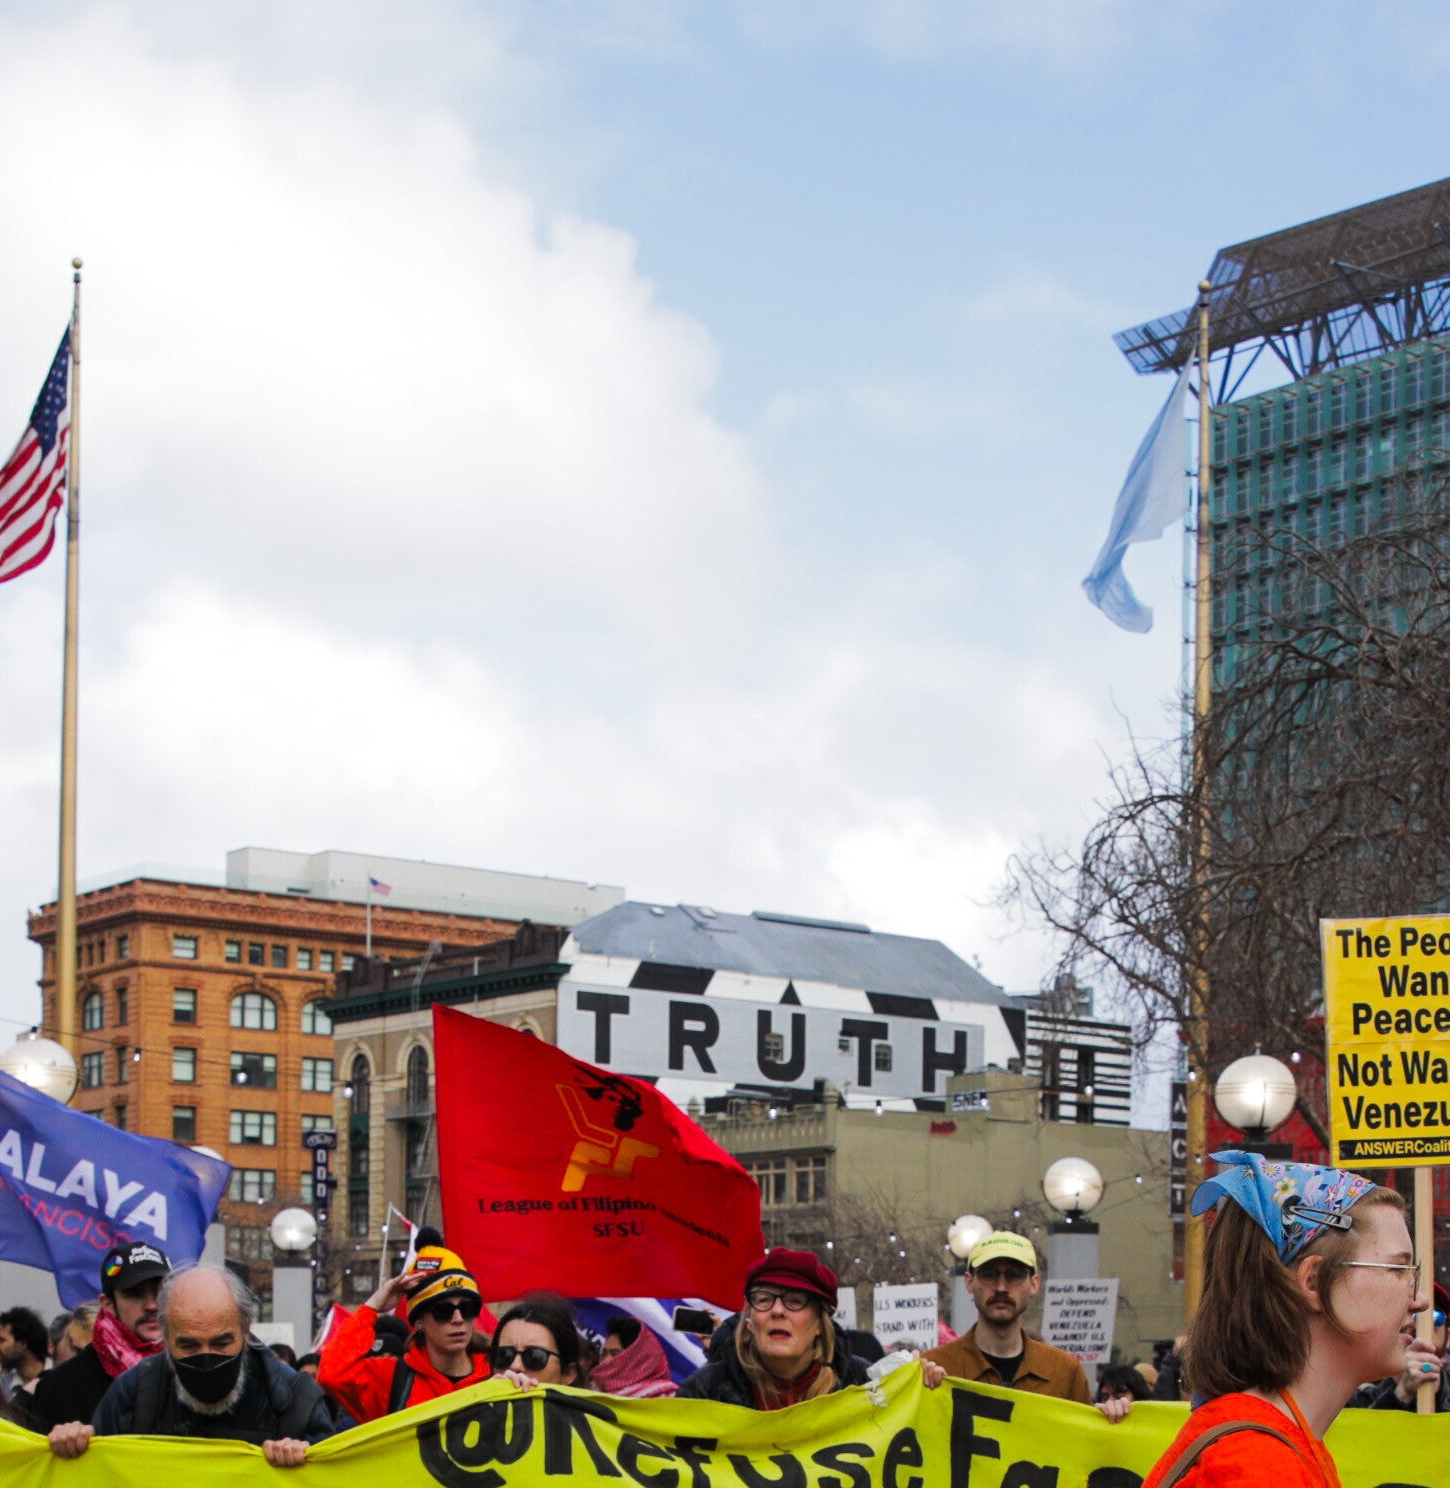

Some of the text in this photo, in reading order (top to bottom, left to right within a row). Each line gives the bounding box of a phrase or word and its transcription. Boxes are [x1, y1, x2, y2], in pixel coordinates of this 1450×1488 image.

[1336, 928, 1391, 958] The
[577, 990, 967, 1093] TRUTH
[1338, 1053, 1392, 1087] Not
[478, 1199, 552, 1215] League
[558, 1198, 578, 1211] of
[581, 1197, 656, 1215] Filipino
